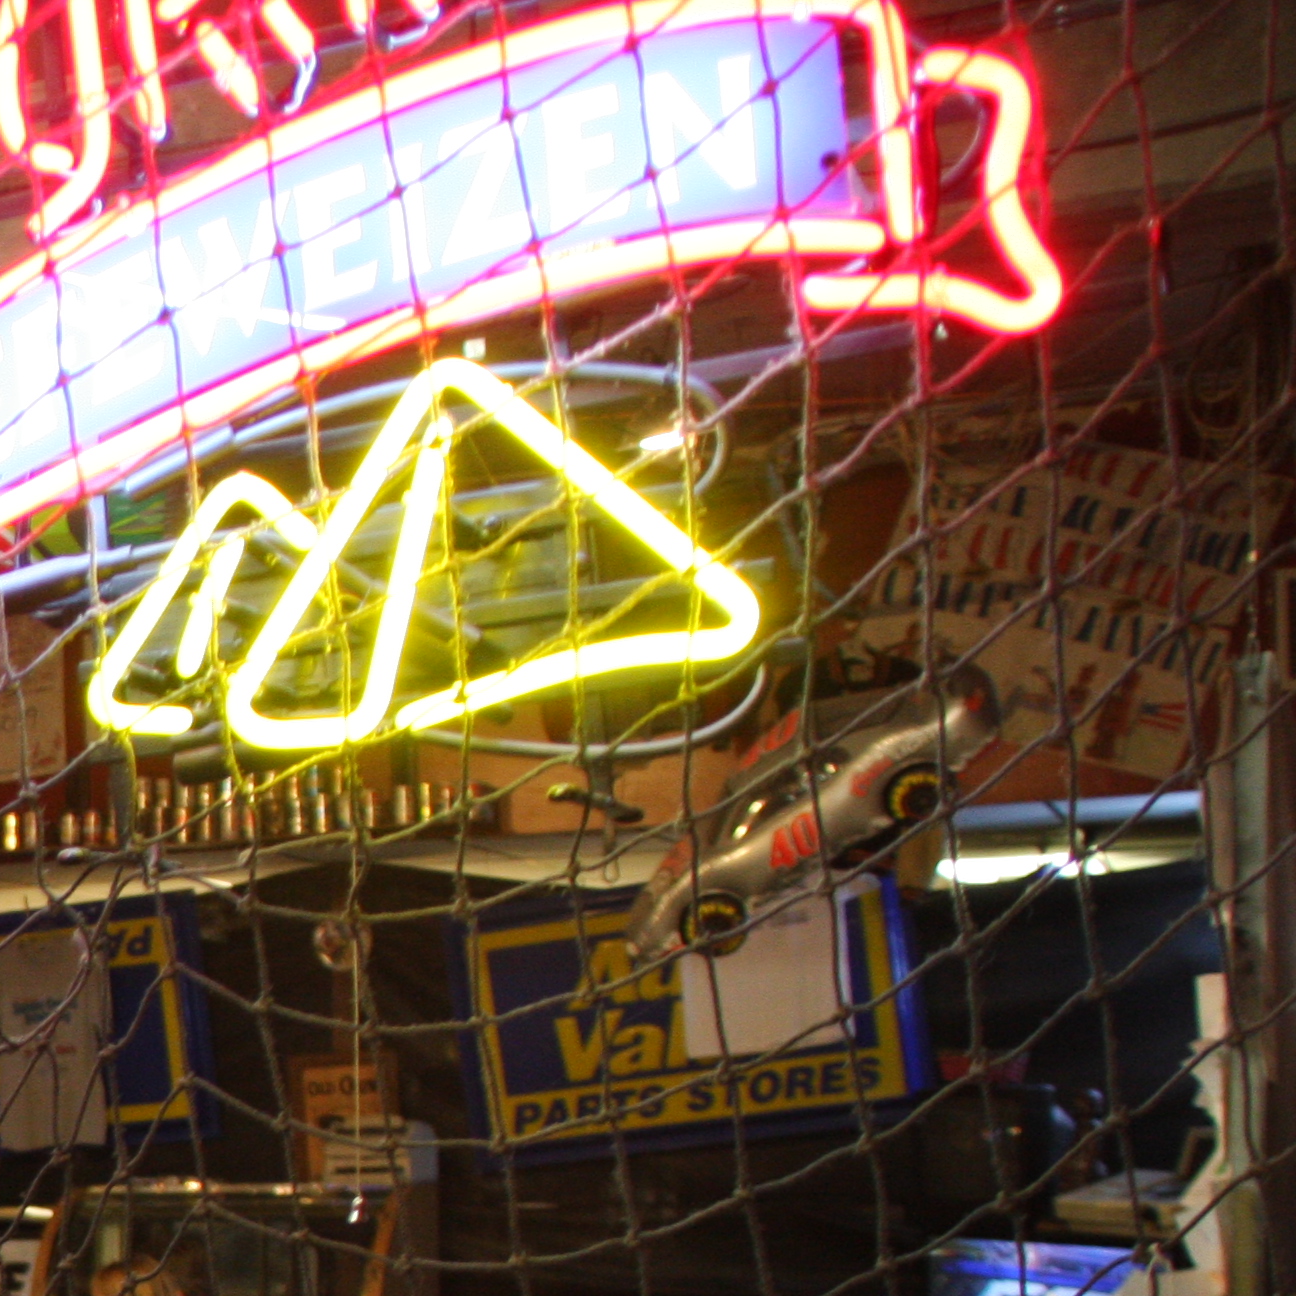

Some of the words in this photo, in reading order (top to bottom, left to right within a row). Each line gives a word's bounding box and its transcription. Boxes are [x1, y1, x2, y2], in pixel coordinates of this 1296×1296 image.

[769, 811, 820, 870] 40
[514, 1081, 667, 1136] PARTS
[686, 1055, 884, 1114] STORES
